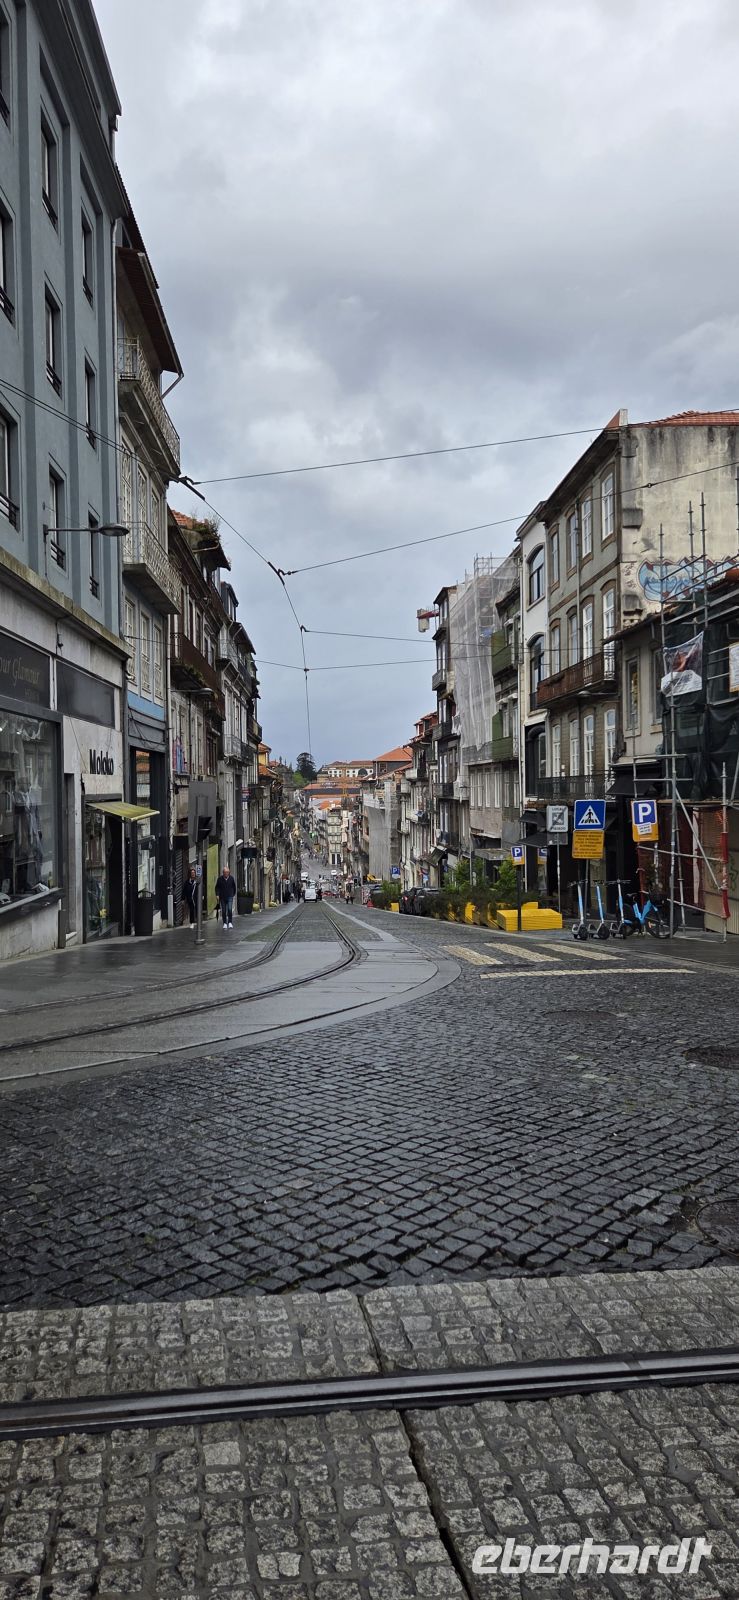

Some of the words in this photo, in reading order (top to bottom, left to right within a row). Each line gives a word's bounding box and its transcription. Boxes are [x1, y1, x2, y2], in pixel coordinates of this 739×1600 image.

[12, 656, 40, 688] Glamour
[89, 749, 114, 776] Moloko
[638, 803, 652, 823] P
[514, 847, 521, 857] P
